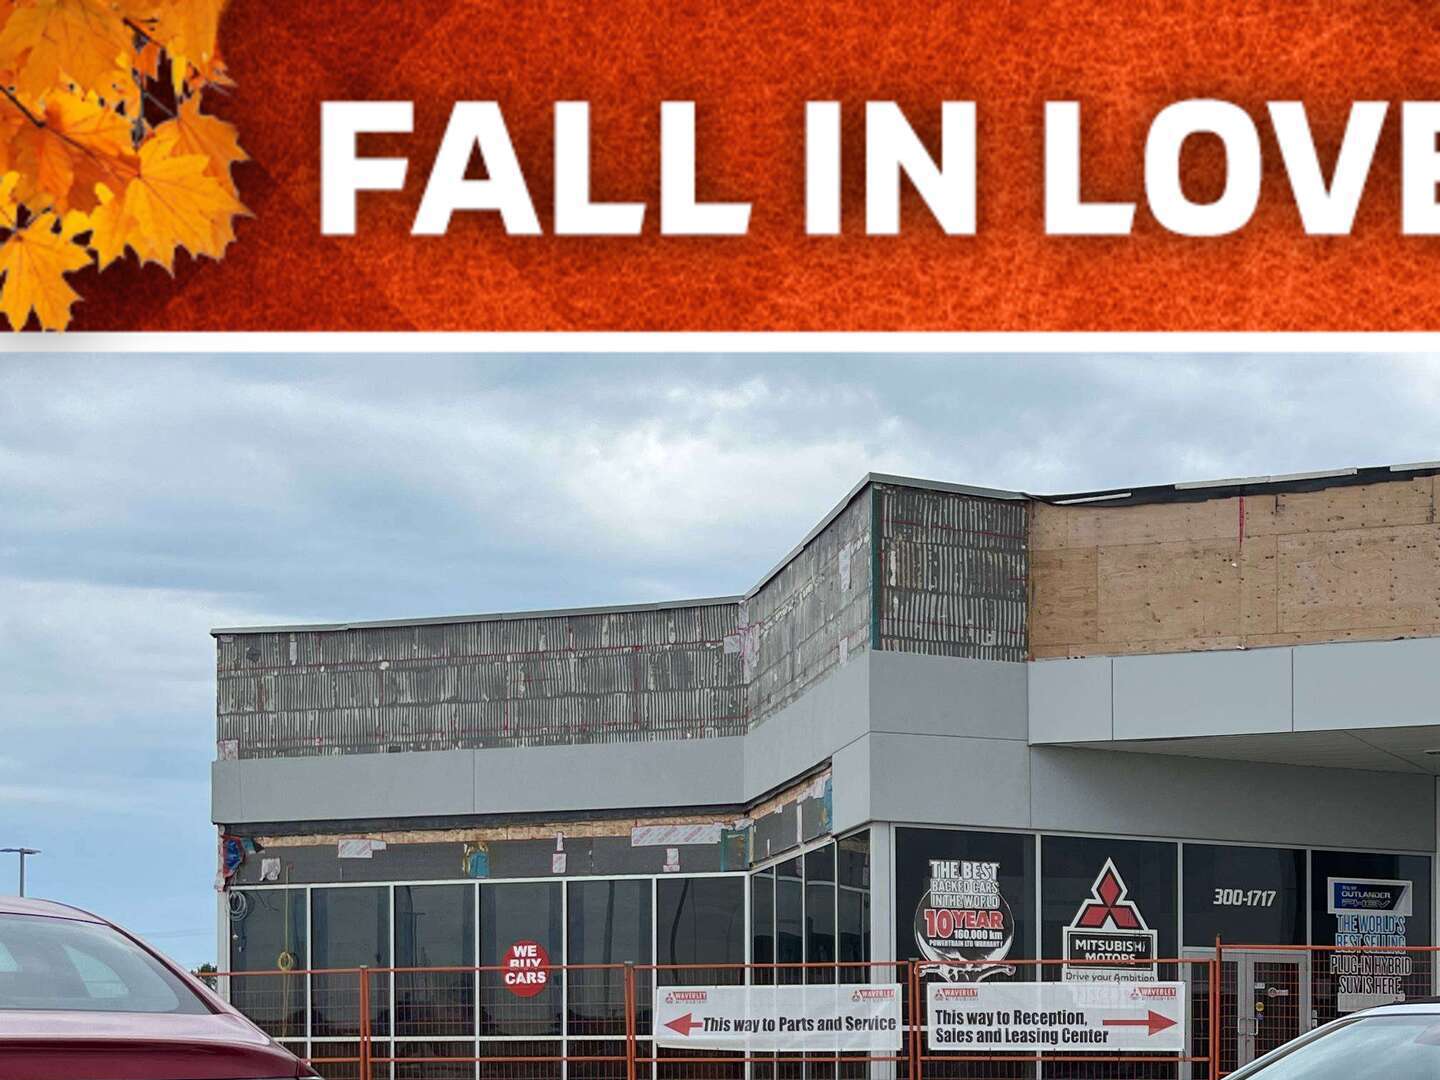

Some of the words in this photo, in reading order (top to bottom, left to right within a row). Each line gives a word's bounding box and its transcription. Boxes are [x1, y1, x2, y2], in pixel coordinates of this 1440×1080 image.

[929, 859, 960, 879] THE
[961, 860, 1000, 880] BEST
[931, 880, 970, 893] BACKED
[972, 880, 999, 894] CARS
[1341, 890, 1391, 899] OUTLANDER
[931, 894, 942, 908] IN
[943, 894, 964, 908] THE
[1213, 888, 1277, 907] 300-1717
[924, 909, 954, 938] 10
[952, 909, 1004, 929] YEAR
[1336, 914, 1358, 933] THE
[1359, 914, 1406, 934] WORLD'S
[989, 930, 1003, 940] km
[512, 944, 537, 957] WE
[1075, 939, 1146, 953] MITSUBISHI
[1335, 933, 1362, 953] BEST
[1363, 933, 1407, 954] SELLING
[510, 958, 542, 969] BUY
[1085, 953, 1136, 965] MOTORS
[1330, 954, 1373, 975] PLUG-IN
[1374, 955, 1412, 976] HYBRID
[505, 971, 547, 985] CARS
[1065, 972, 1089, 981] Drive
[1092, 974, 1111, 982] your
[1114, 974, 1155, 982] Ambition
[1340, 975, 1360, 994] SUV
[1361, 975, 1373, 994] IS
[1374, 976, 1402, 995] HERE
[703, 1016, 730, 1032] This
[734, 1018, 759, 1036] way
[762, 1017, 774, 1032] to
[779, 1016, 814, 1032] Parts
[817, 1016, 842, 1031] and
[845, 1015, 897, 1031] Service
[935, 1009, 964, 1025] This
[966, 1012, 994, 1029] way
[997, 1010, 1010, 1025] to
[1013, 1009, 1088, 1028] Reception,
[936, 1028, 973, 1043] Sales
[976, 1028, 1002, 1043] and
[1005, 1028, 1059, 1045] Leasing
[1062, 1028, 1109, 1043] Center
